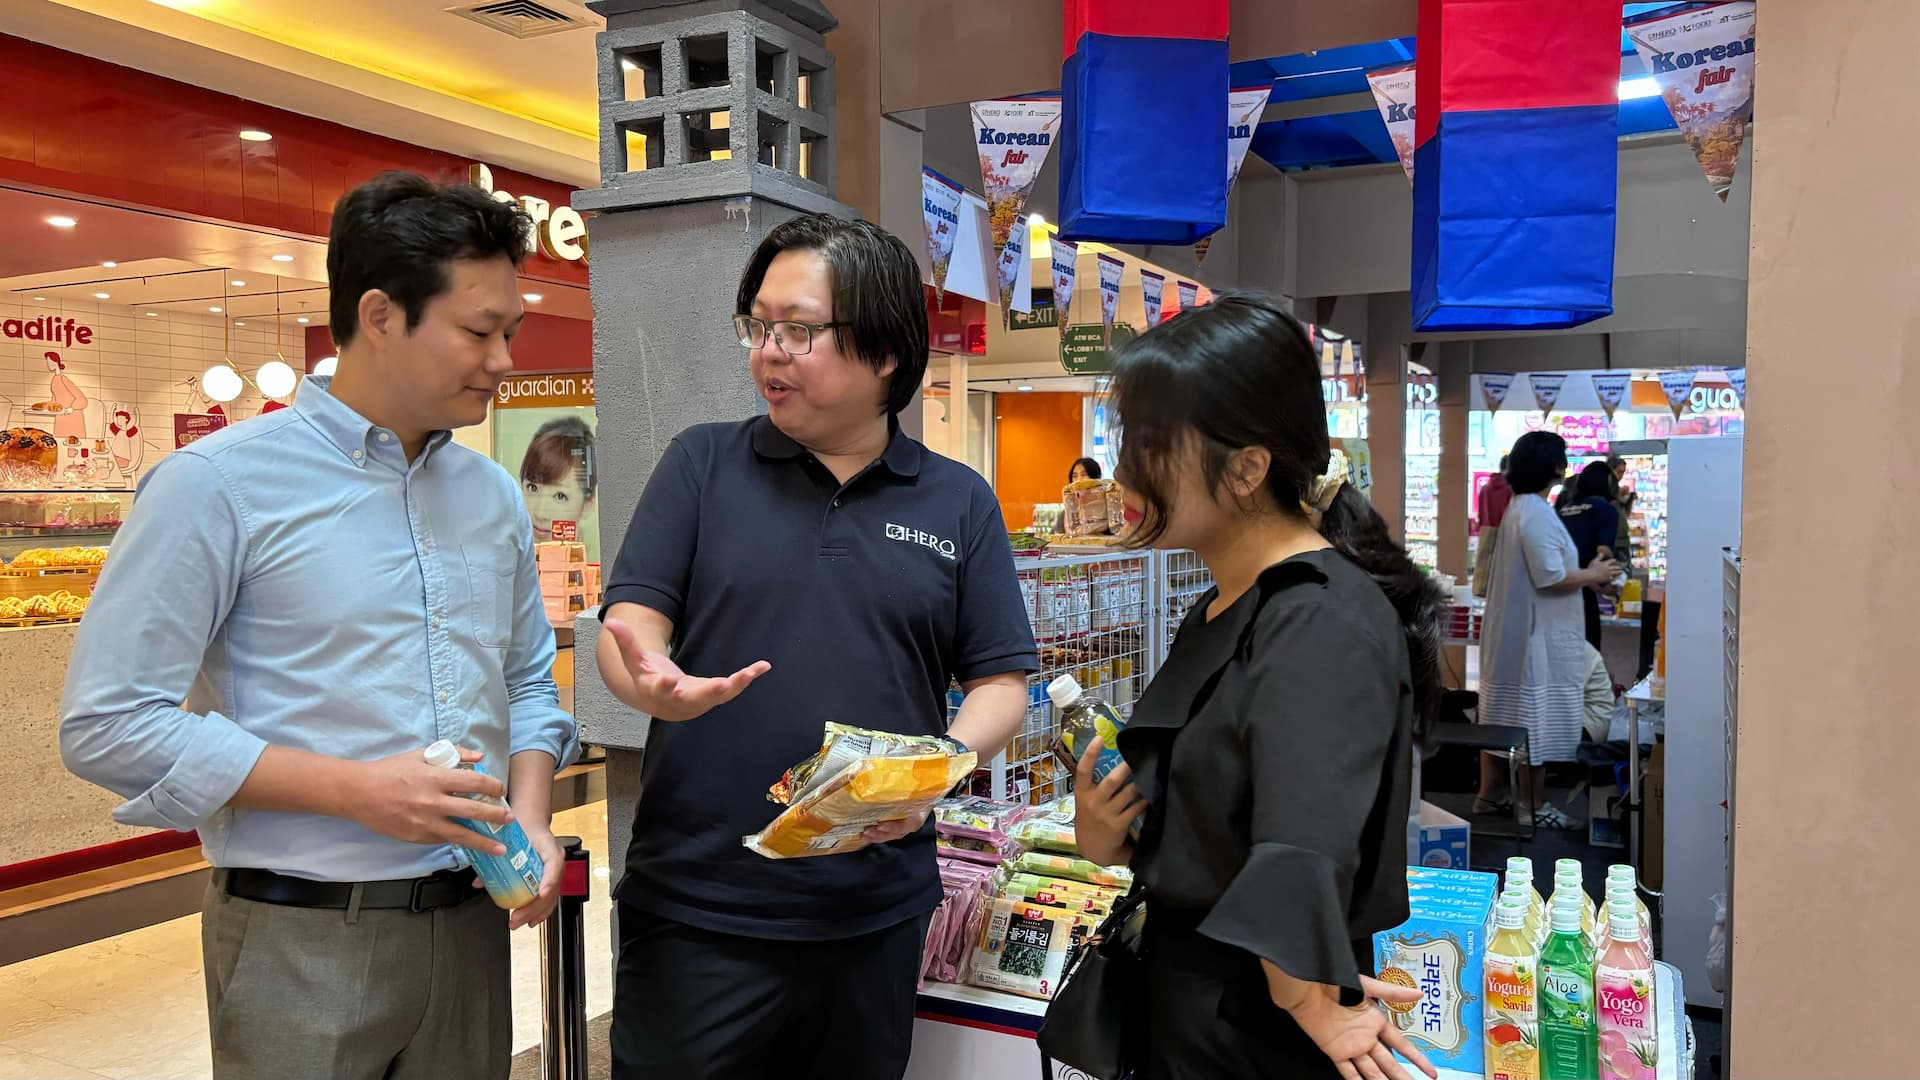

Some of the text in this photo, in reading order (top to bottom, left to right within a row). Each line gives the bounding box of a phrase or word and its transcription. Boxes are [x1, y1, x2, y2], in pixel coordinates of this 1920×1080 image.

[1694, 65, 1736, 94] fair
[979, 127, 1050, 146] Korean
[1000, 148, 1029, 169] fair
[924, 197, 958, 225] Korean
[1052, 258, 1075, 277] Korean
[1027, 307, 1054, 324] EXIT
[0, 314, 93, 348] adlife
[498, 376, 576, 403] guardian
[1558, 425, 1592, 437] Produk
[905, 527, 955, 555] HERO
[1421, 953, 1441, 1032] 크라운산도
[1487, 976, 1534, 998] Yogur de
[1544, 976, 1578, 994] Aloe
[1503, 998, 1533, 1012] Savila
[1600, 990, 1644, 1016] Yogo
[1613, 1013, 1644, 1029] Vera
